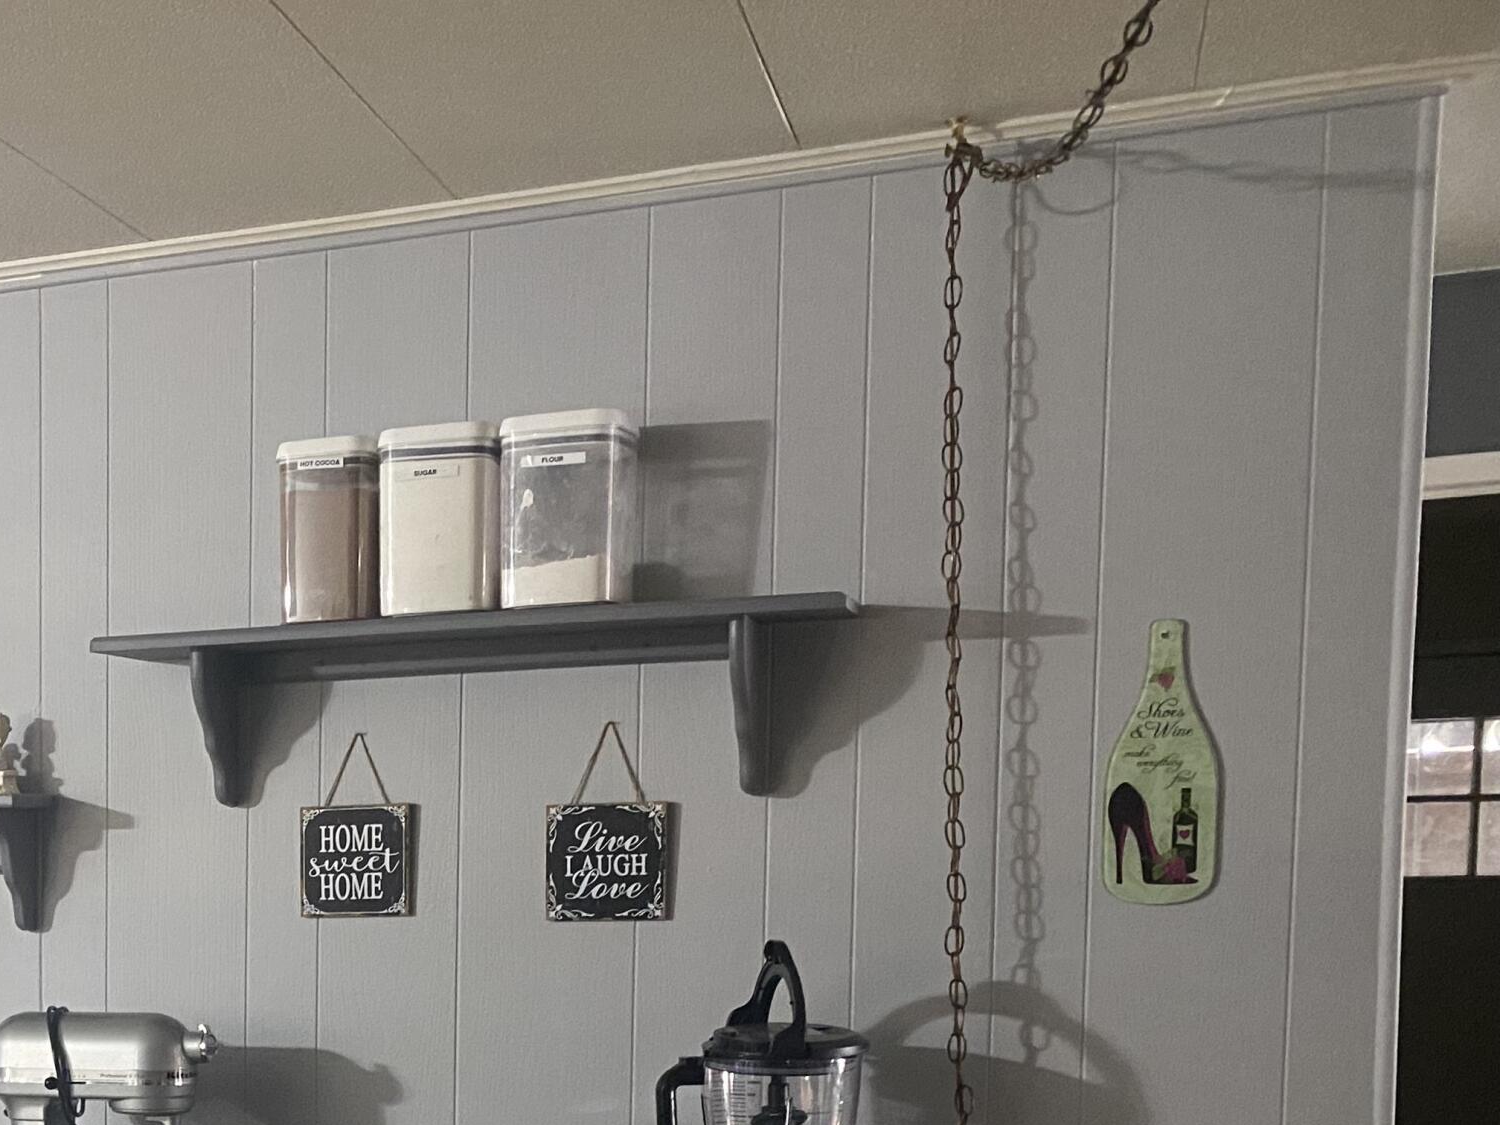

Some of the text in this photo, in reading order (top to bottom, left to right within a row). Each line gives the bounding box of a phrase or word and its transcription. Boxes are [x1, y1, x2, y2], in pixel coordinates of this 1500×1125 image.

[1137, 697, 1185, 719] Shoes
[1130, 720, 1193, 738] & Wine
[319, 823, 384, 853] HOME
[567, 820, 647, 853] Live
[308, 847, 400, 878] sweet
[566, 853, 648, 878] LAUGH
[319, 872, 384, 901] HOME
[564, 867, 649, 901] Love
